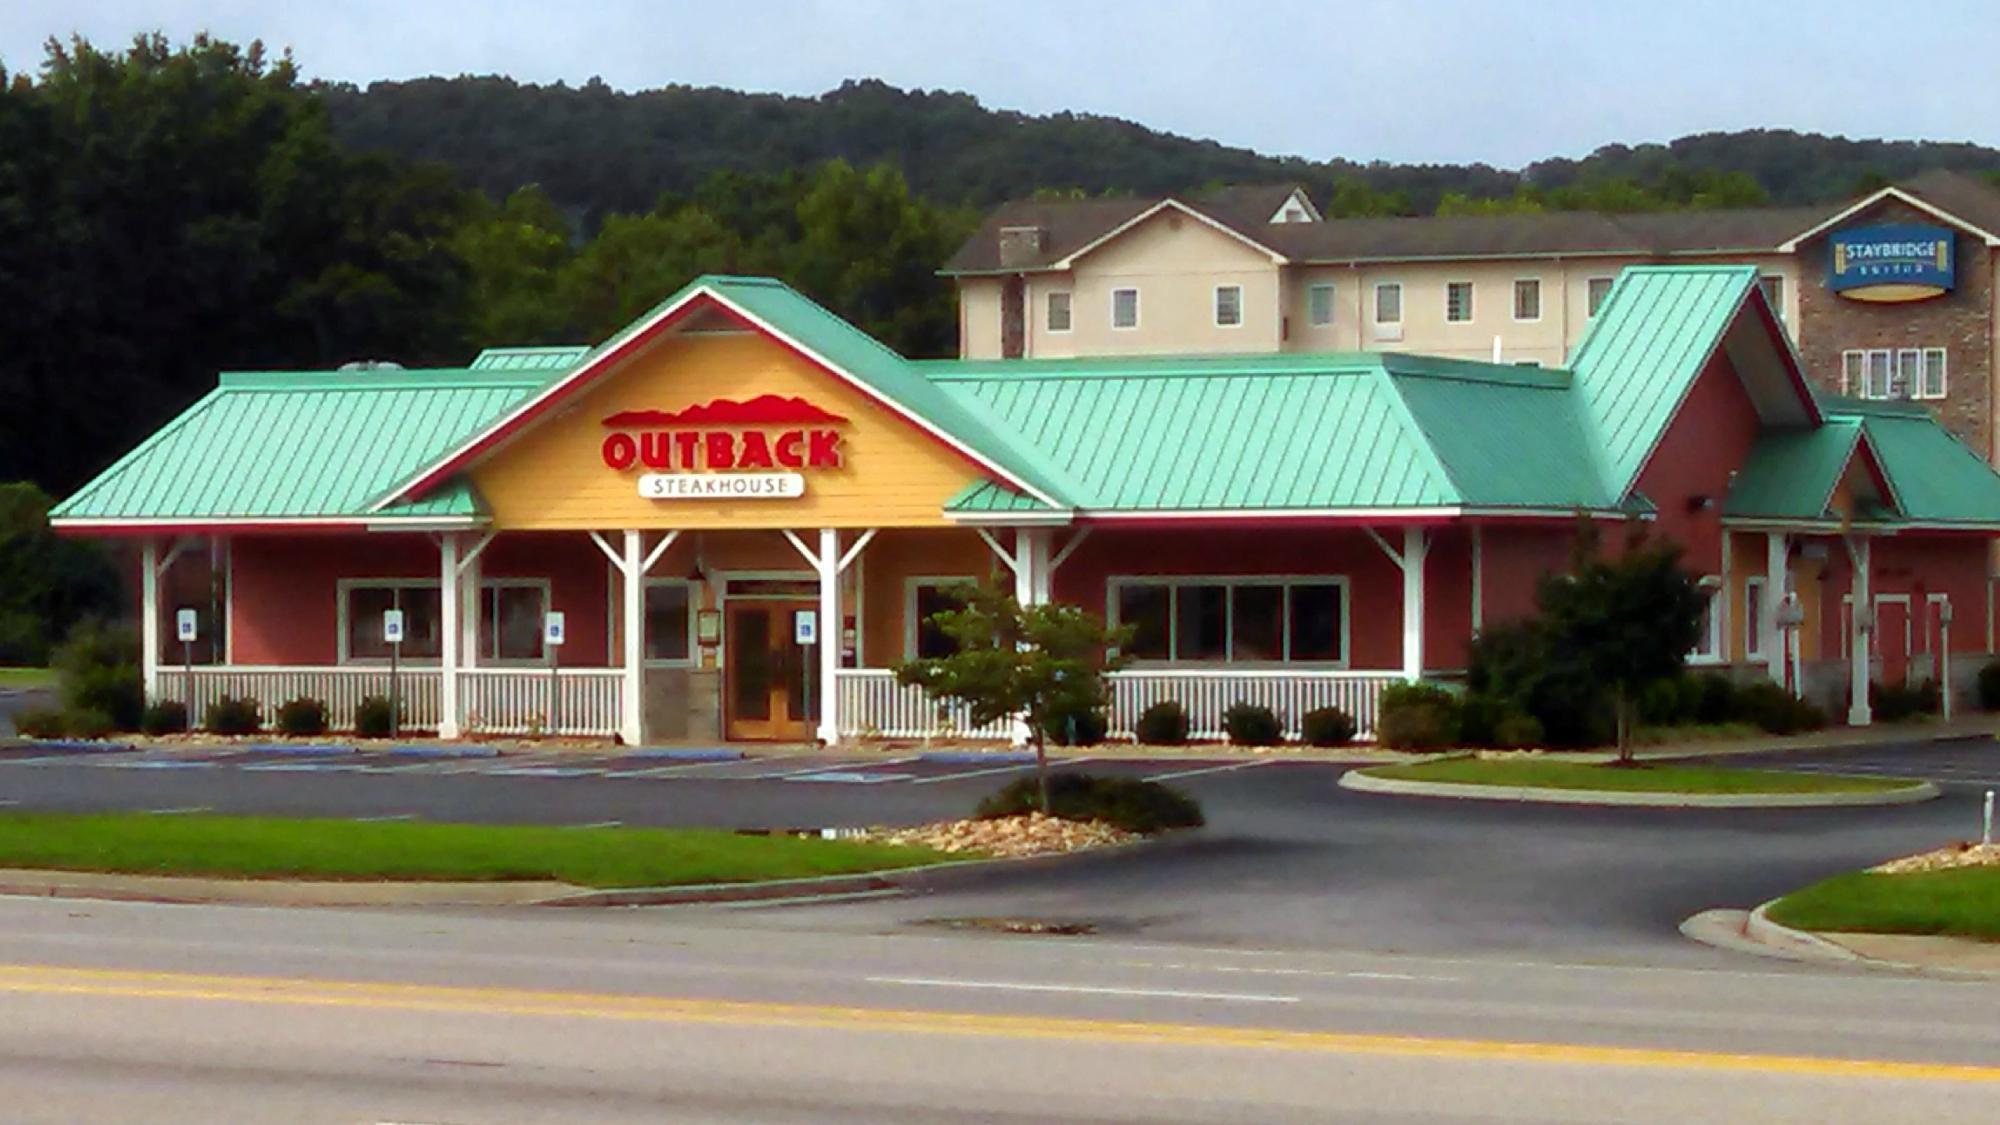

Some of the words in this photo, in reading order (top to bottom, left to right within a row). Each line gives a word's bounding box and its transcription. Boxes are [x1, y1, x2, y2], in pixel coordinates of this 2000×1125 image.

[1845, 241, 1936, 259] STAYBRIDGE
[602, 430, 841, 470] OUTBACK
[653, 477, 789, 494] STEAKHOUSE
